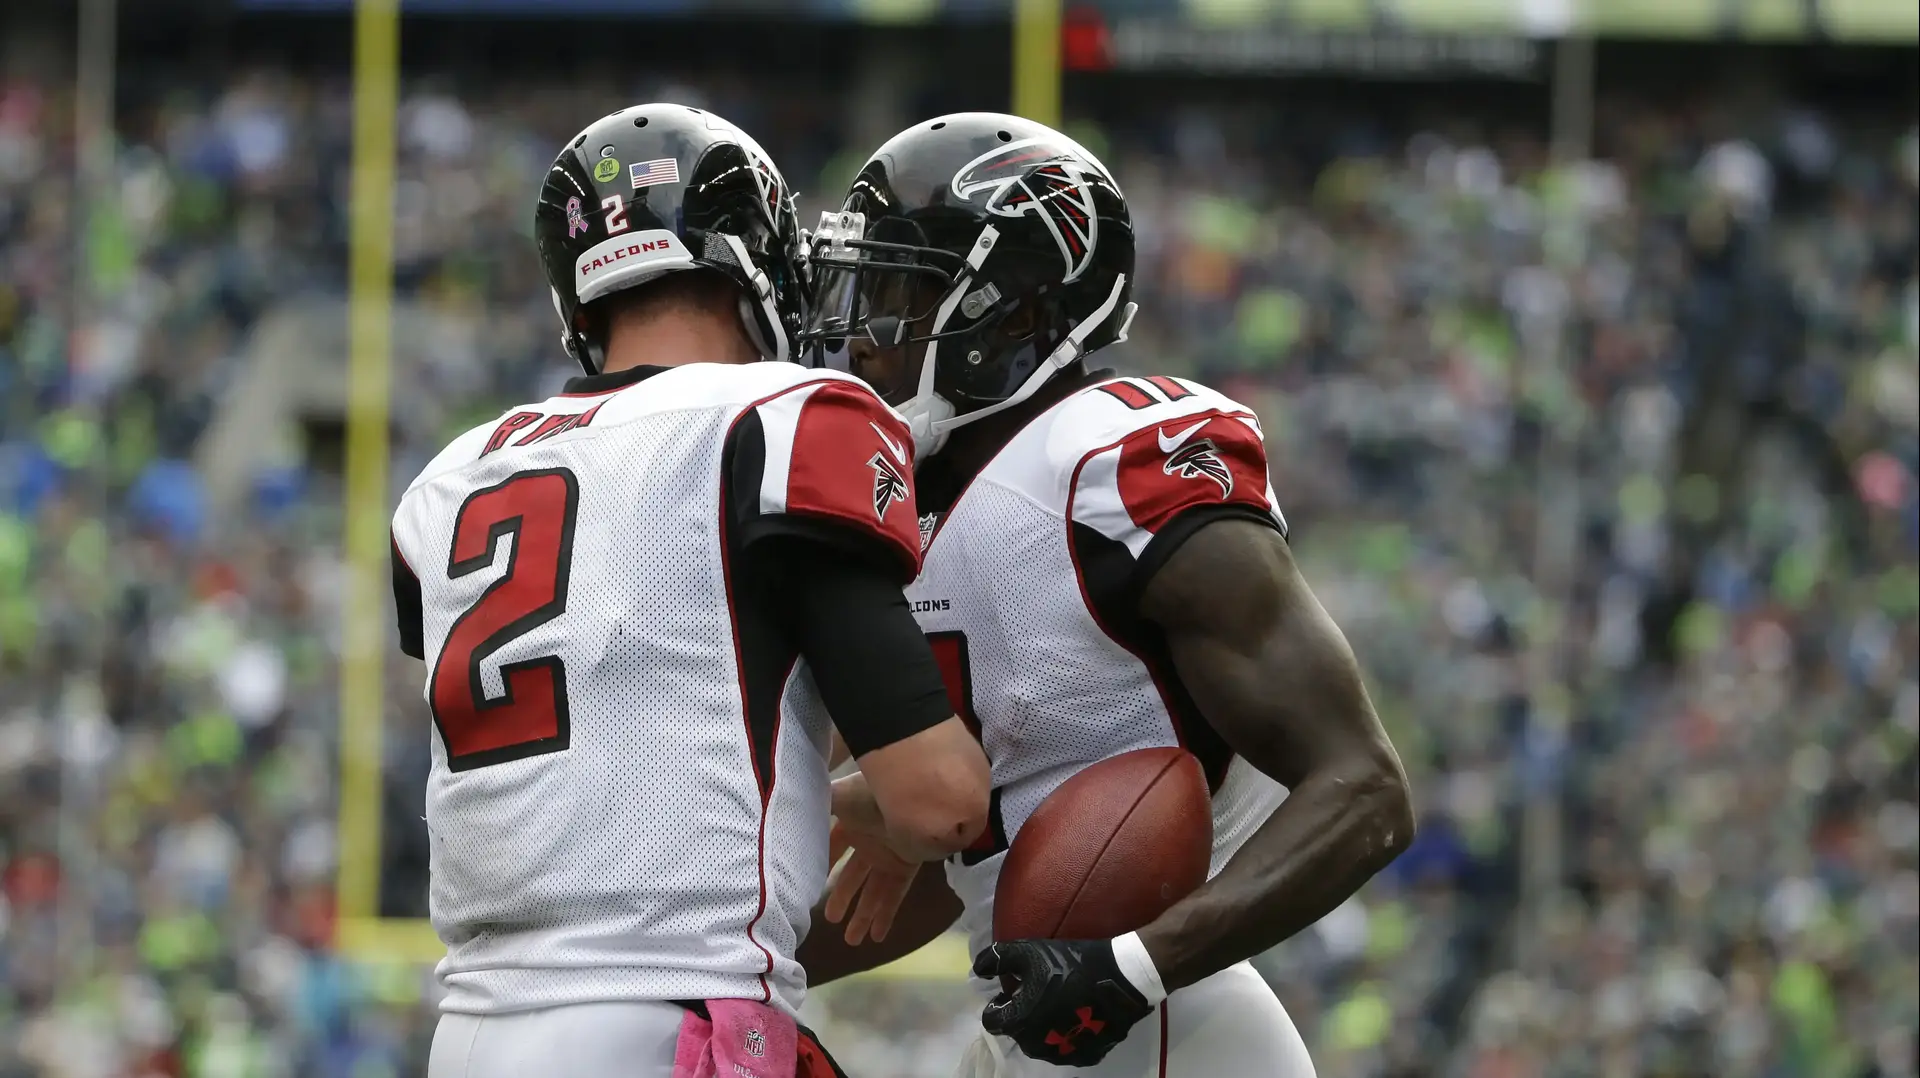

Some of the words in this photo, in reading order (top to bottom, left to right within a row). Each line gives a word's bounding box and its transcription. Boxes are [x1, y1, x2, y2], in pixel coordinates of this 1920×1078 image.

[601, 194, 631, 235] 2
[581, 239, 670, 276] FALCONS
[429, 467, 580, 772] 2
[908, 600, 950, 613] LCONS
